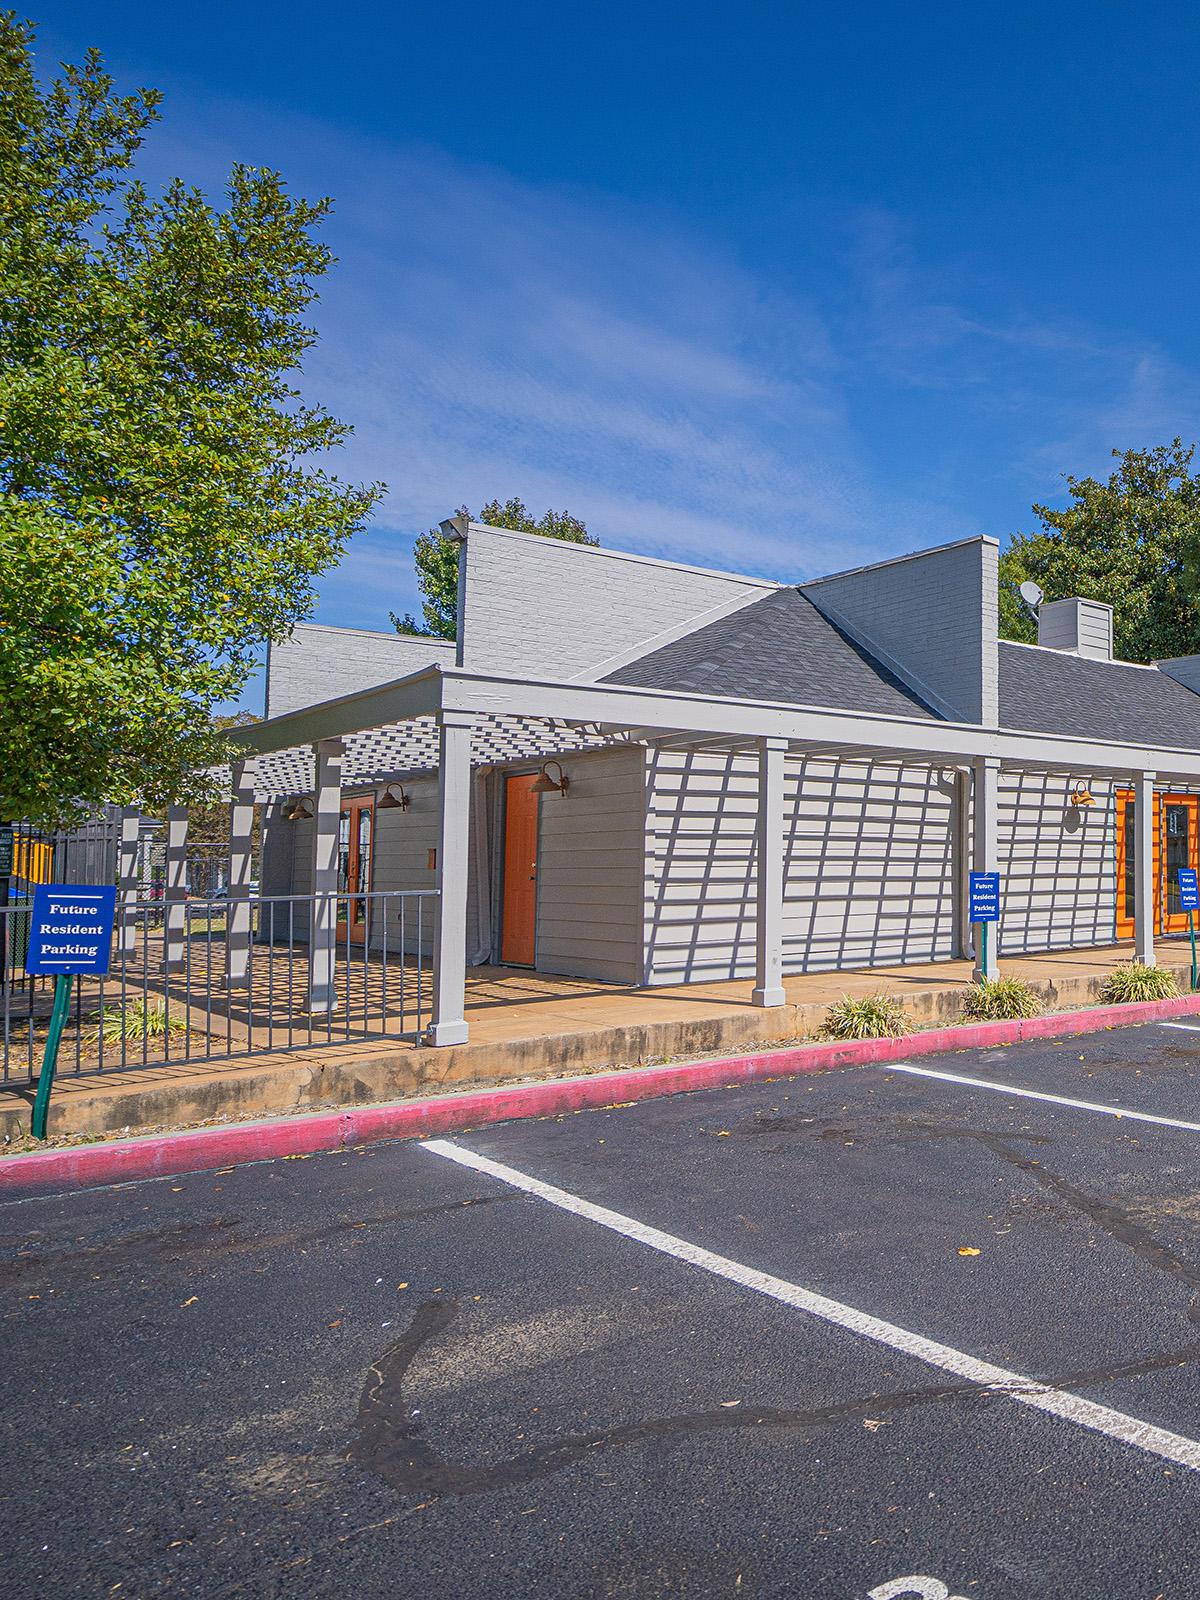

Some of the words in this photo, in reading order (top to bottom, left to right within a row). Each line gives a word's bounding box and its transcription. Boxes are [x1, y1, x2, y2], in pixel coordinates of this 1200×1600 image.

[49, 904, 98, 915] Future
[39, 924, 104, 935] Resident
[40, 944, 98, 957] Parking
